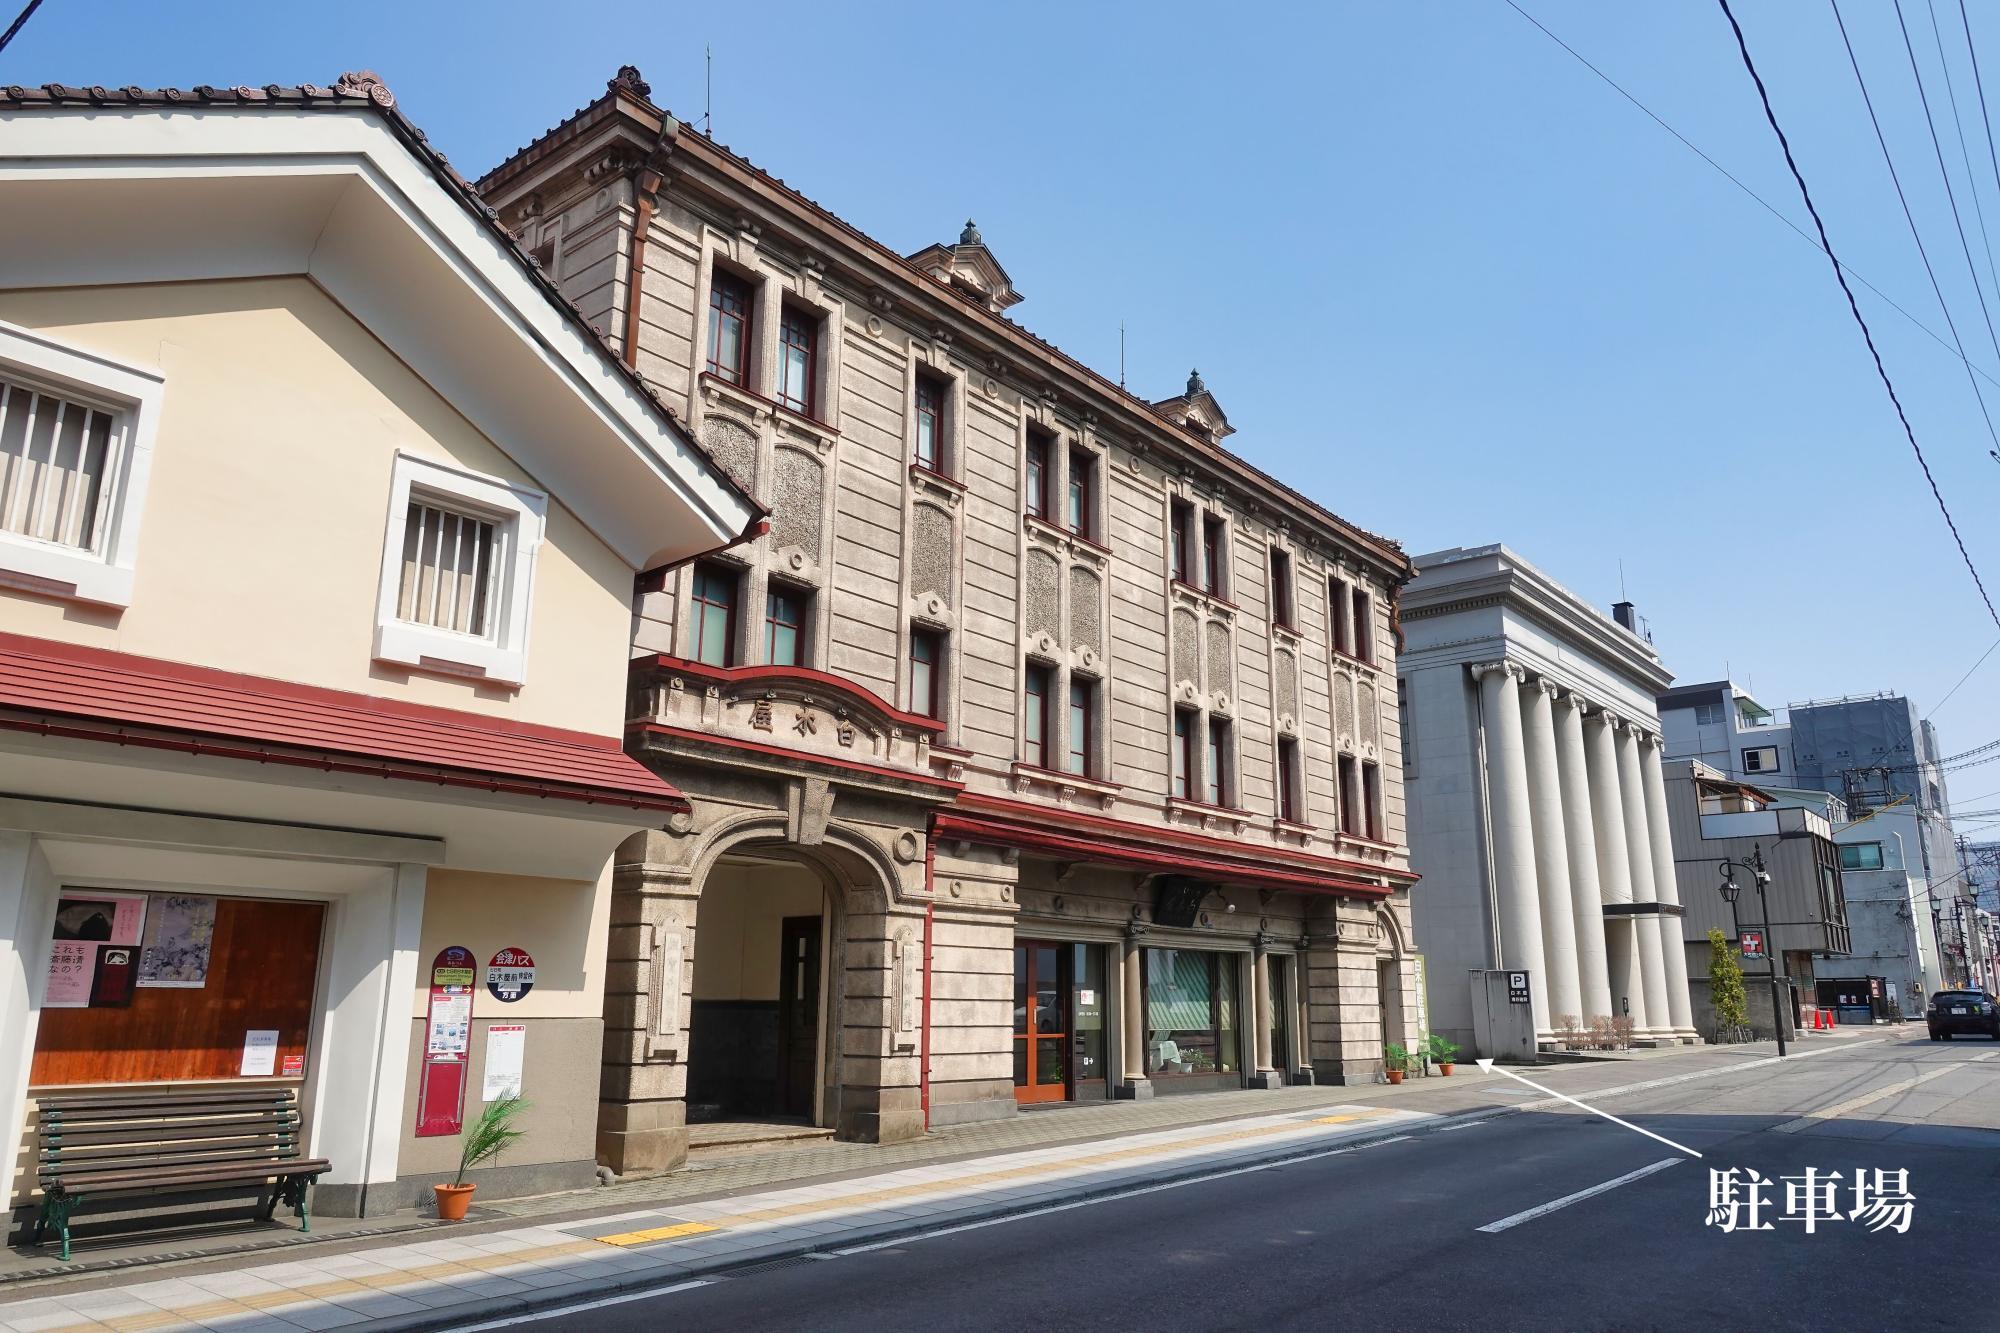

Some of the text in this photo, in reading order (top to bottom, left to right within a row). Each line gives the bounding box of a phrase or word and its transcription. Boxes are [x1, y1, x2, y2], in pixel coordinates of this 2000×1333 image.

[52, 946, 85, 955] これも
[496, 951, 530, 966] 会津バス
[489, 973, 518, 982] 白木屋前
[1514, 976, 1522, 986] P
[502, 991, 517, 999] 方面
